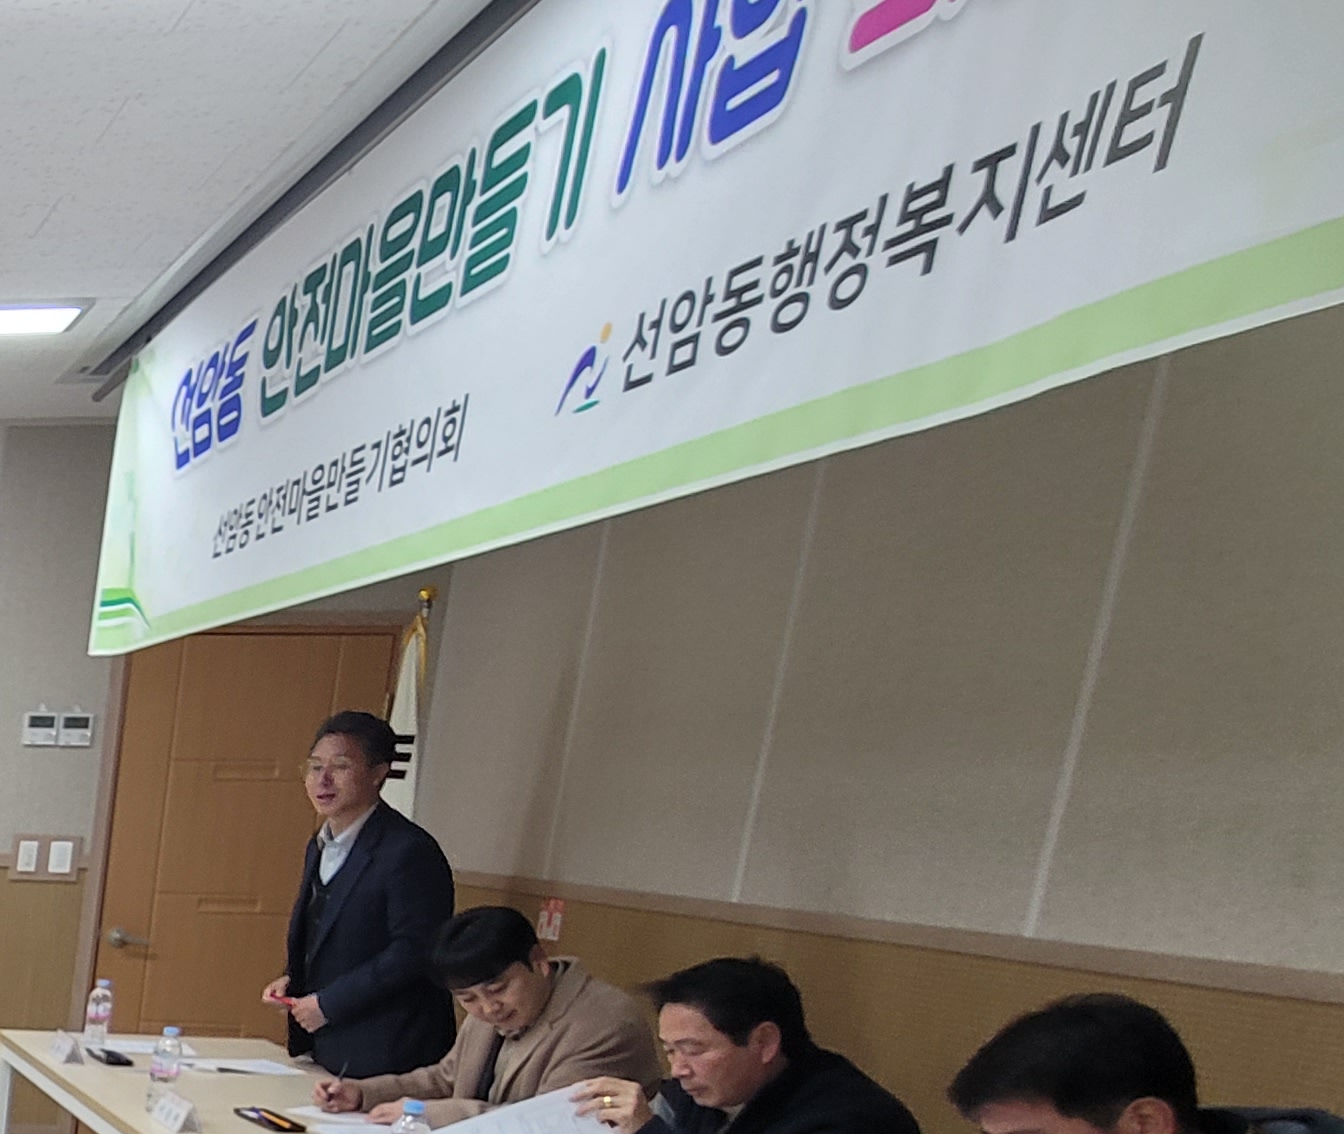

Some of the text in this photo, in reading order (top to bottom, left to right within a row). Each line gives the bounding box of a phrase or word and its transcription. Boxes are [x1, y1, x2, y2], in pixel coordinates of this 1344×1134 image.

[171, 0, 807, 471] 선암동 안전마을만들기 사업
[621, 31, 1205, 393] 선암동행정복지센터
